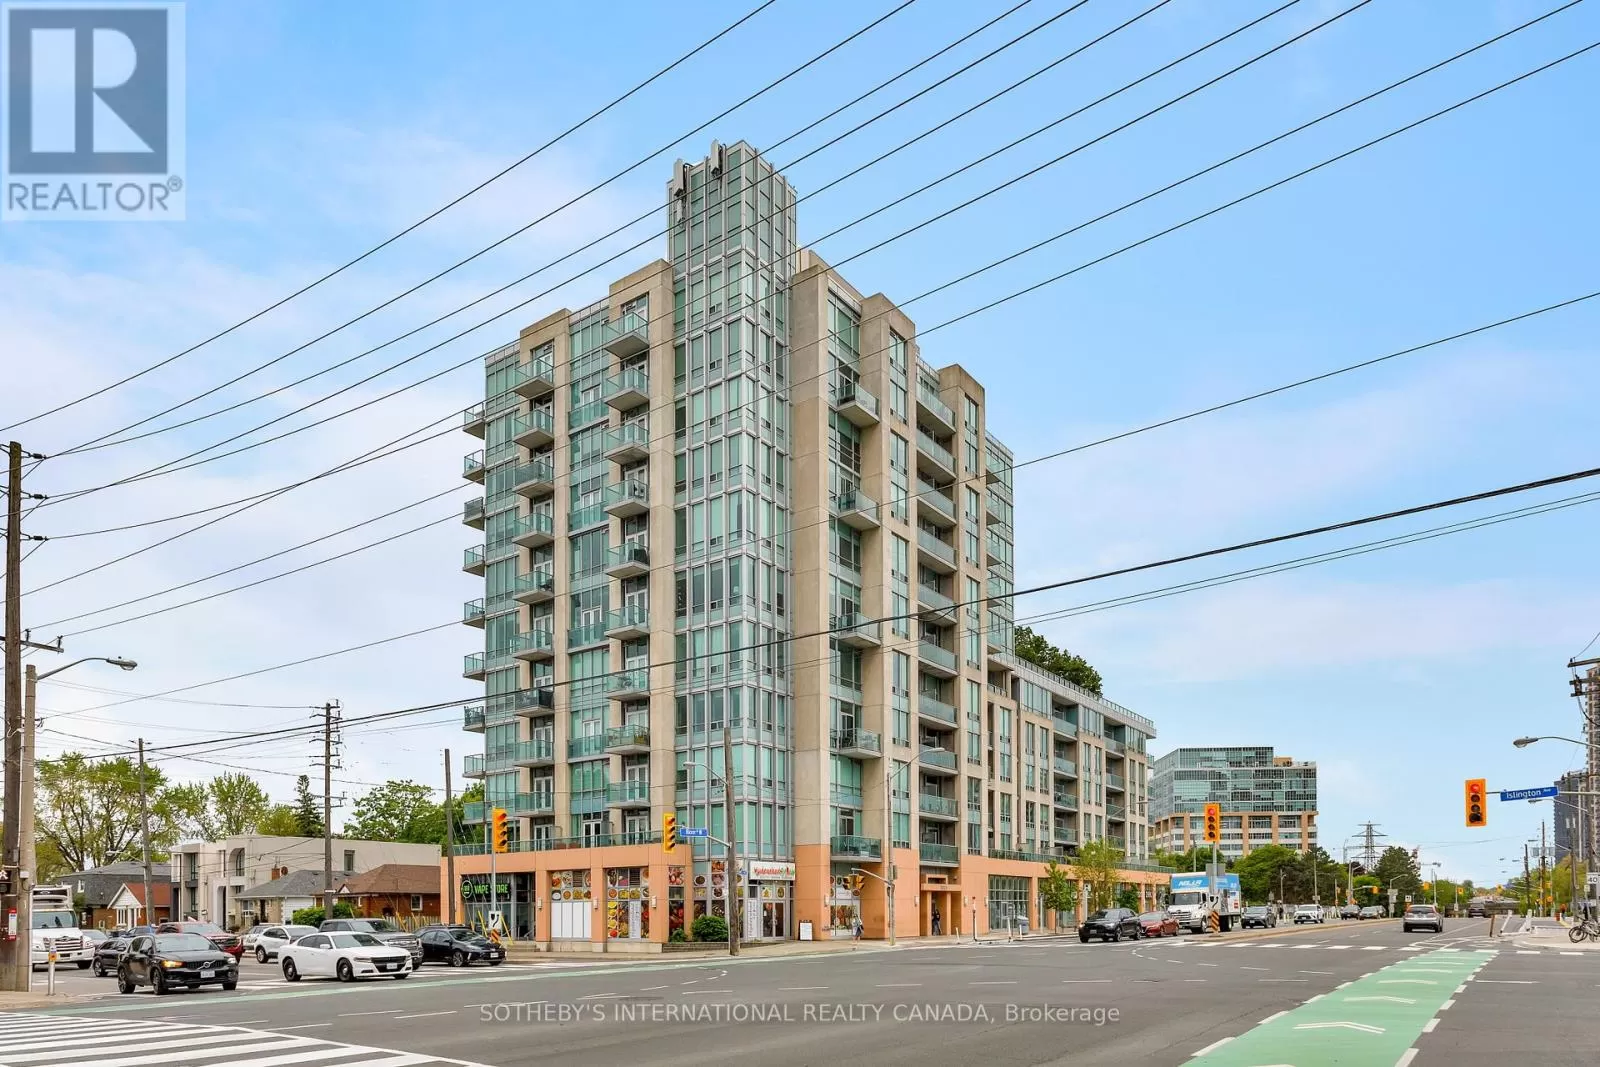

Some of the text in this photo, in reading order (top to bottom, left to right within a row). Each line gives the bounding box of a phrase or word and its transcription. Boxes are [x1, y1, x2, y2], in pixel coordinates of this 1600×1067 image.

[1506, 790, 1542, 799] Islington
[474, 884, 509, 894] VAPE TORE
